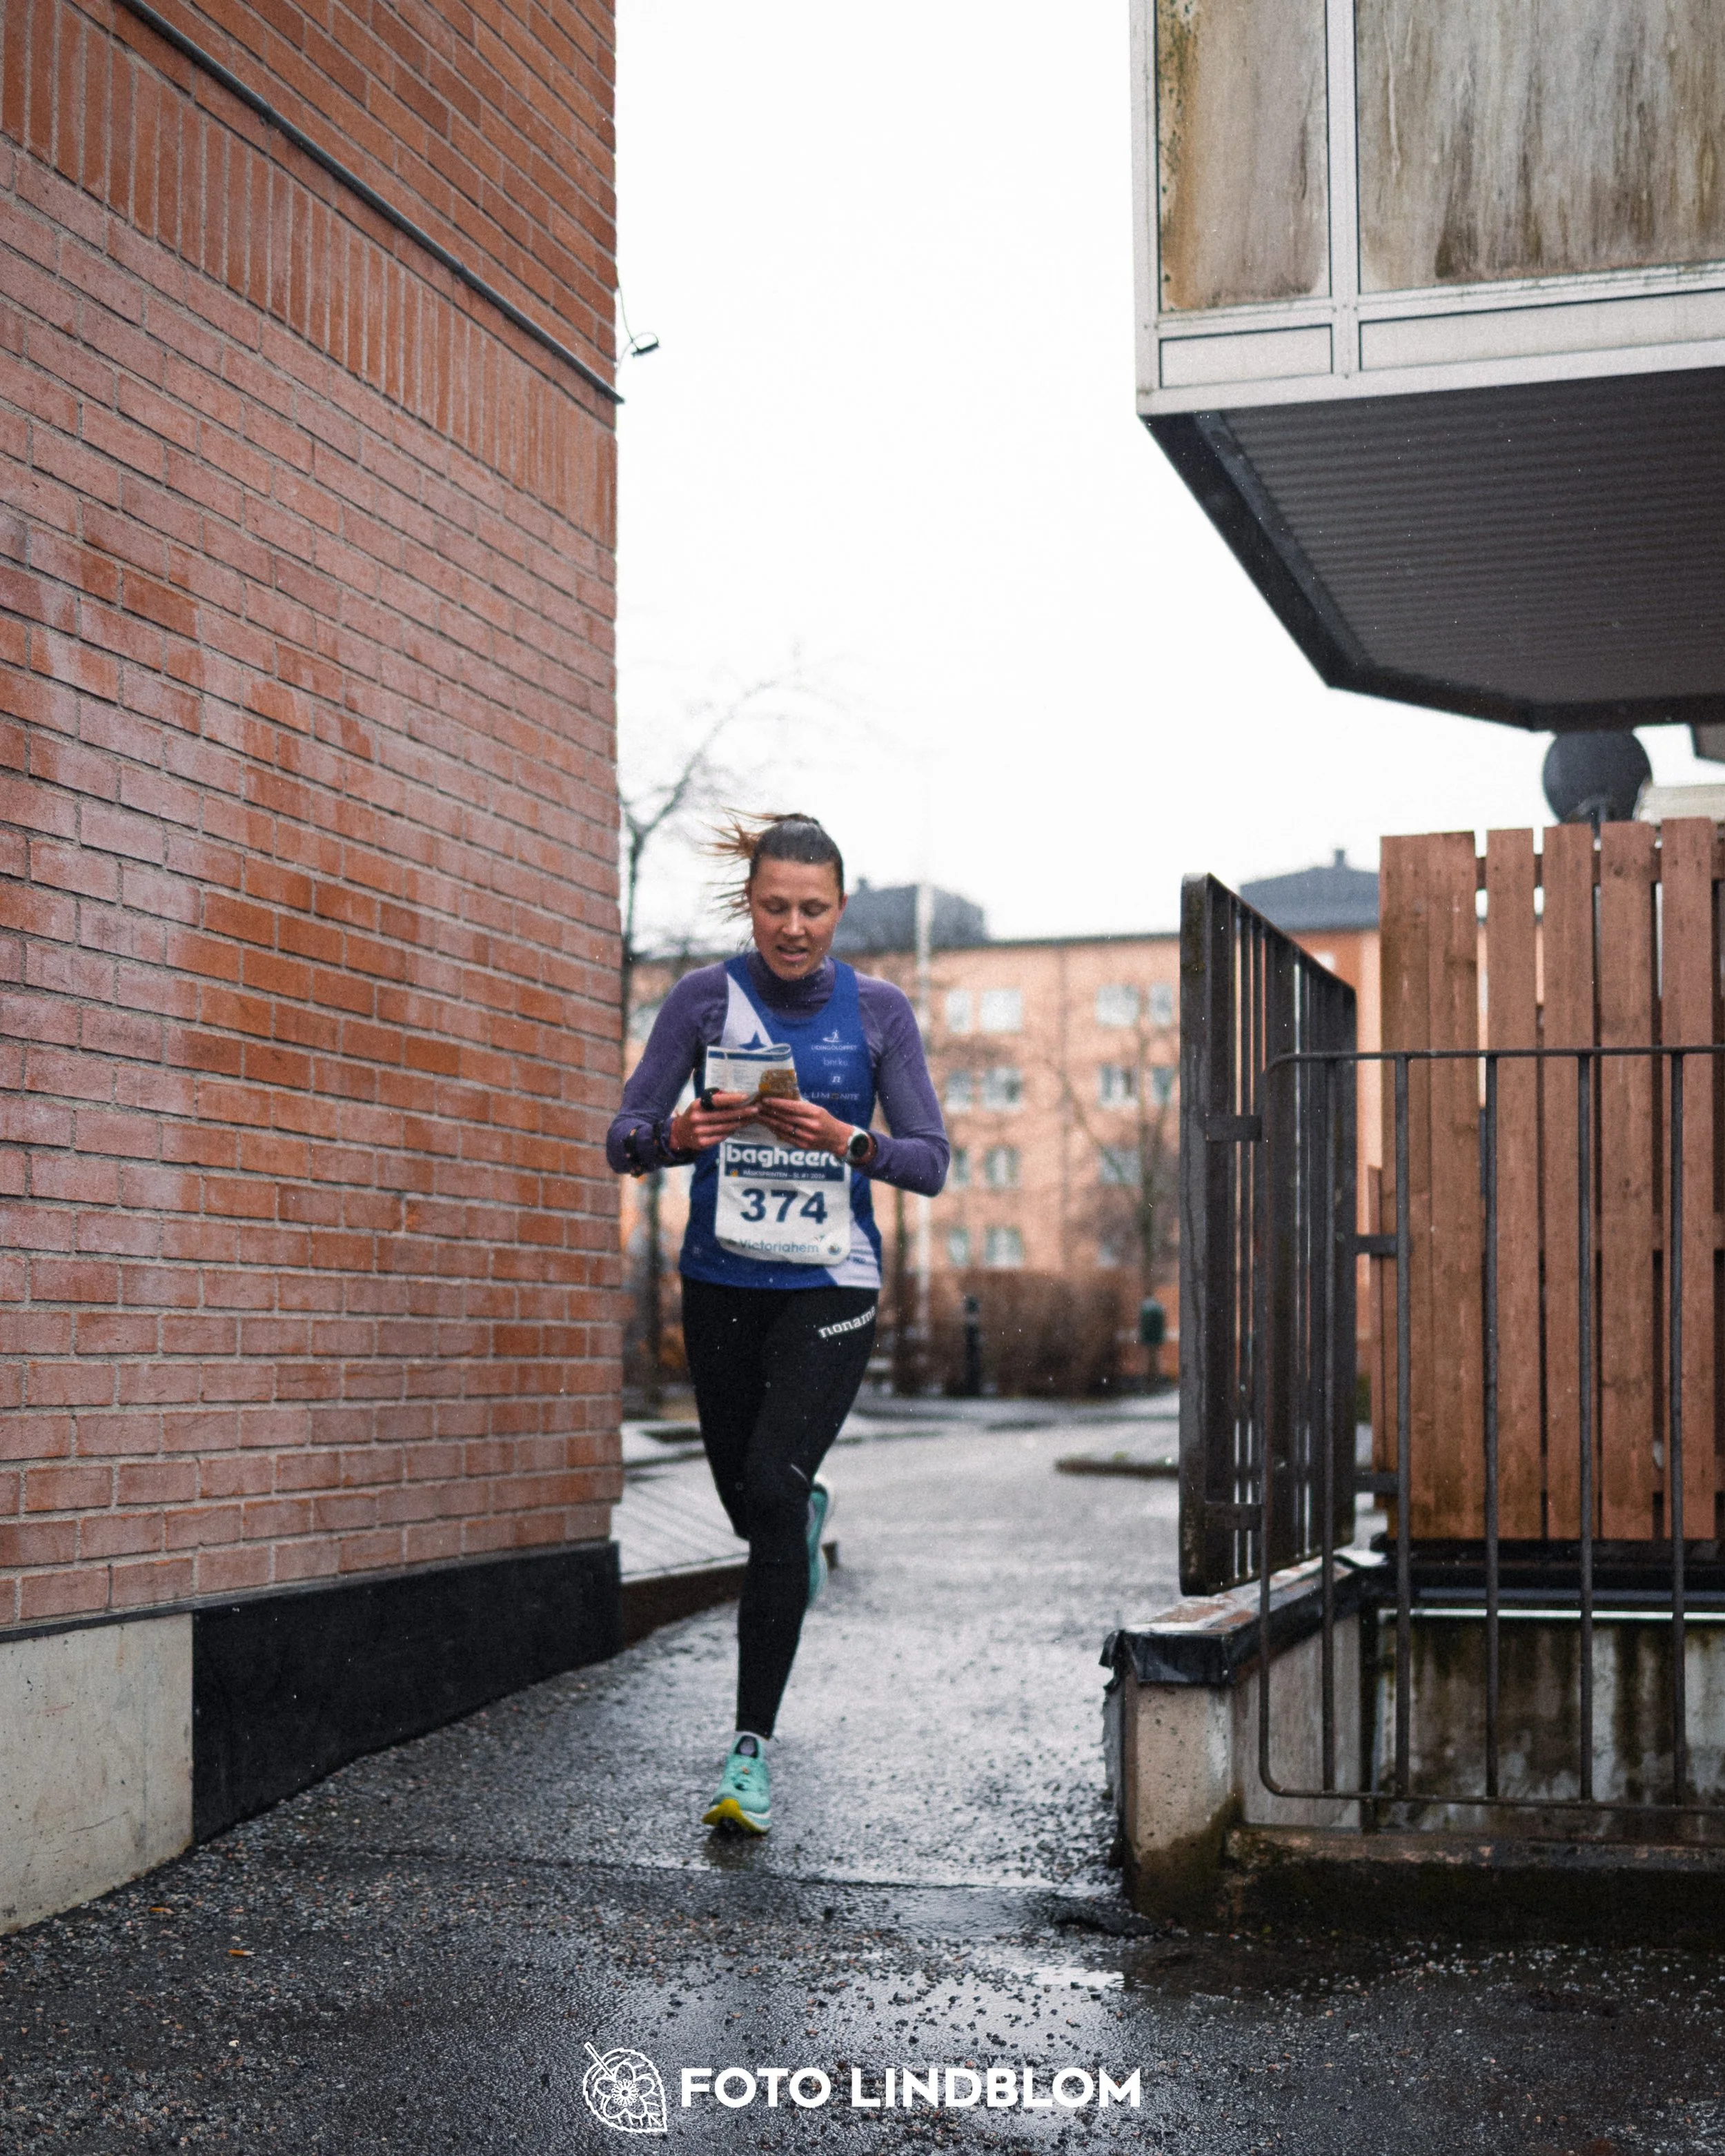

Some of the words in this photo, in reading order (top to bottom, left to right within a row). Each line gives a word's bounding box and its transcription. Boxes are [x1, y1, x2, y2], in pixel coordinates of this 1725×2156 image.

[740, 1188, 827, 1225] 374
[740, 1238, 819, 1254] Victoriahem
[818, 1305, 876, 1338] noname
